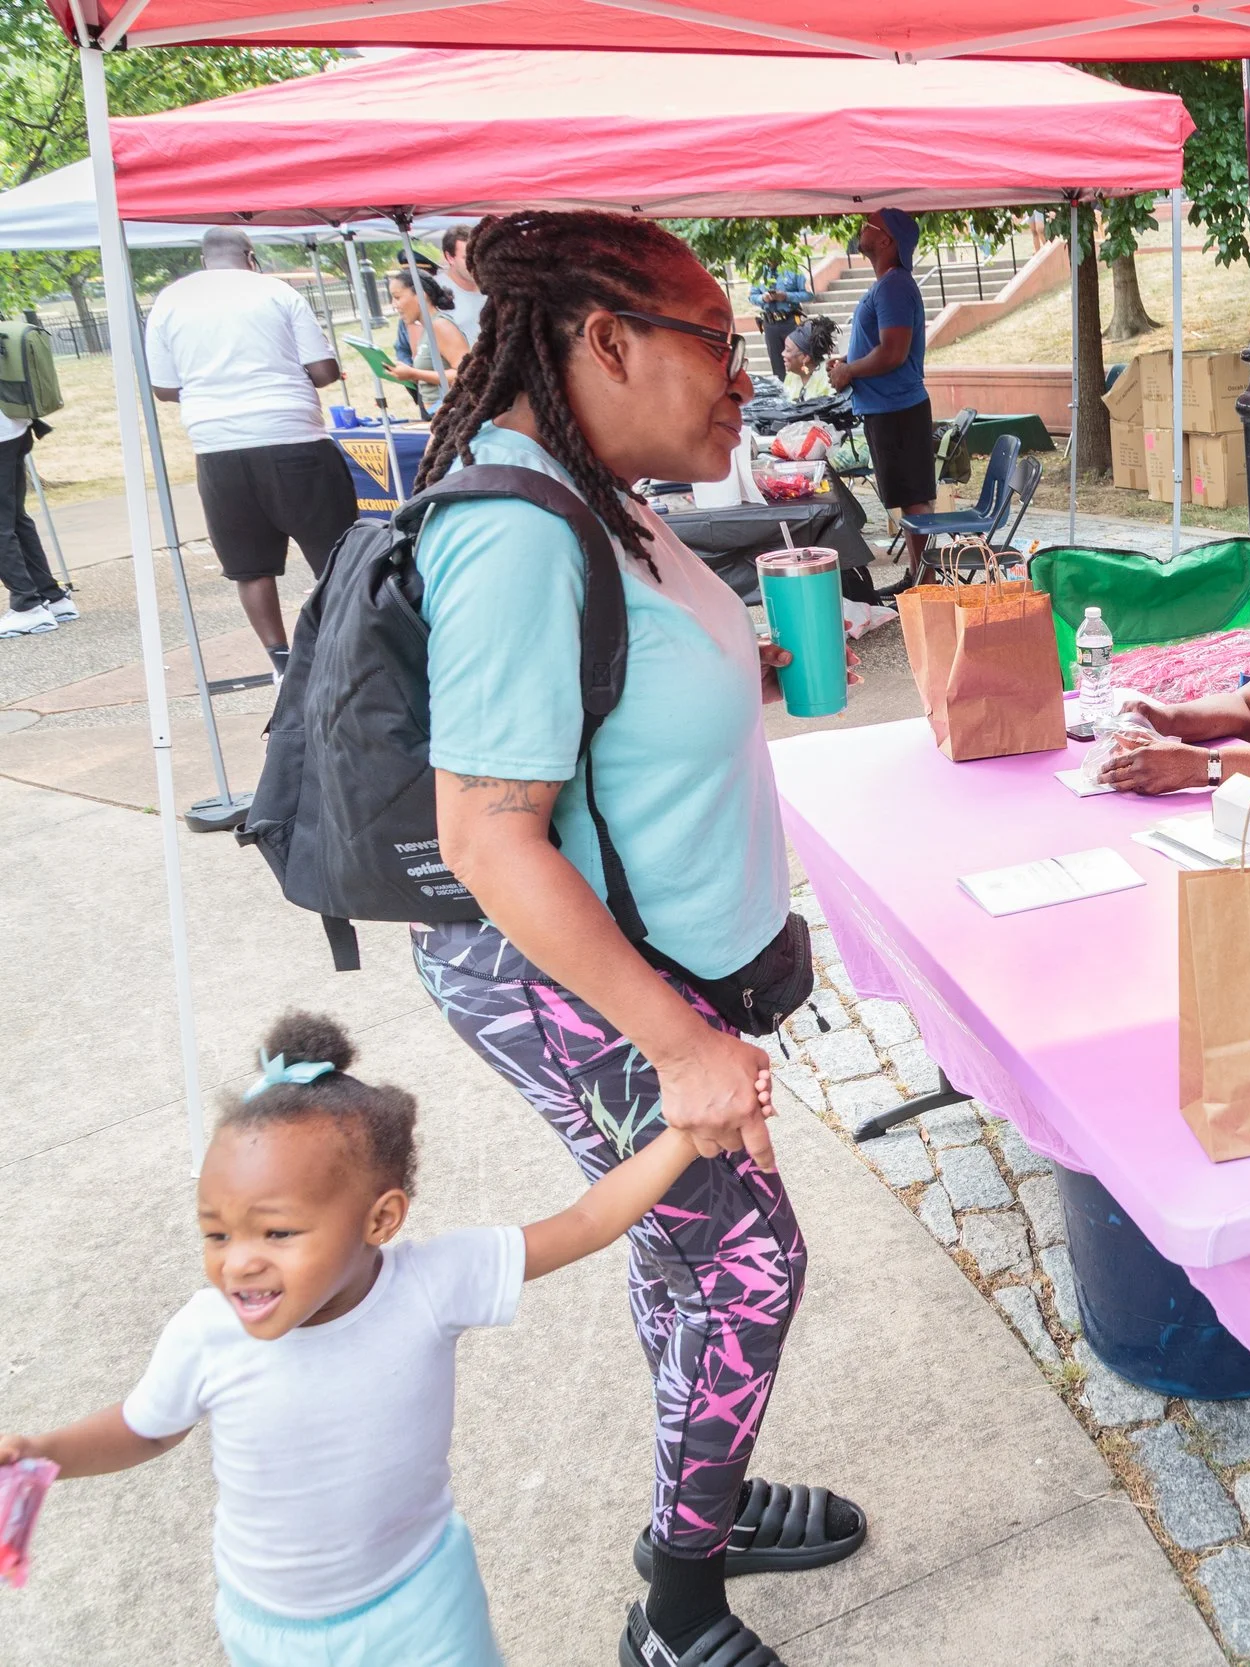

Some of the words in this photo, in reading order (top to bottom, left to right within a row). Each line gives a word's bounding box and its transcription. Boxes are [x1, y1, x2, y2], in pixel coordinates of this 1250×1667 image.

[351, 445, 382, 454] STATE
[394, 839, 439, 853] news
[436, 888, 468, 896] DISCOVERY
